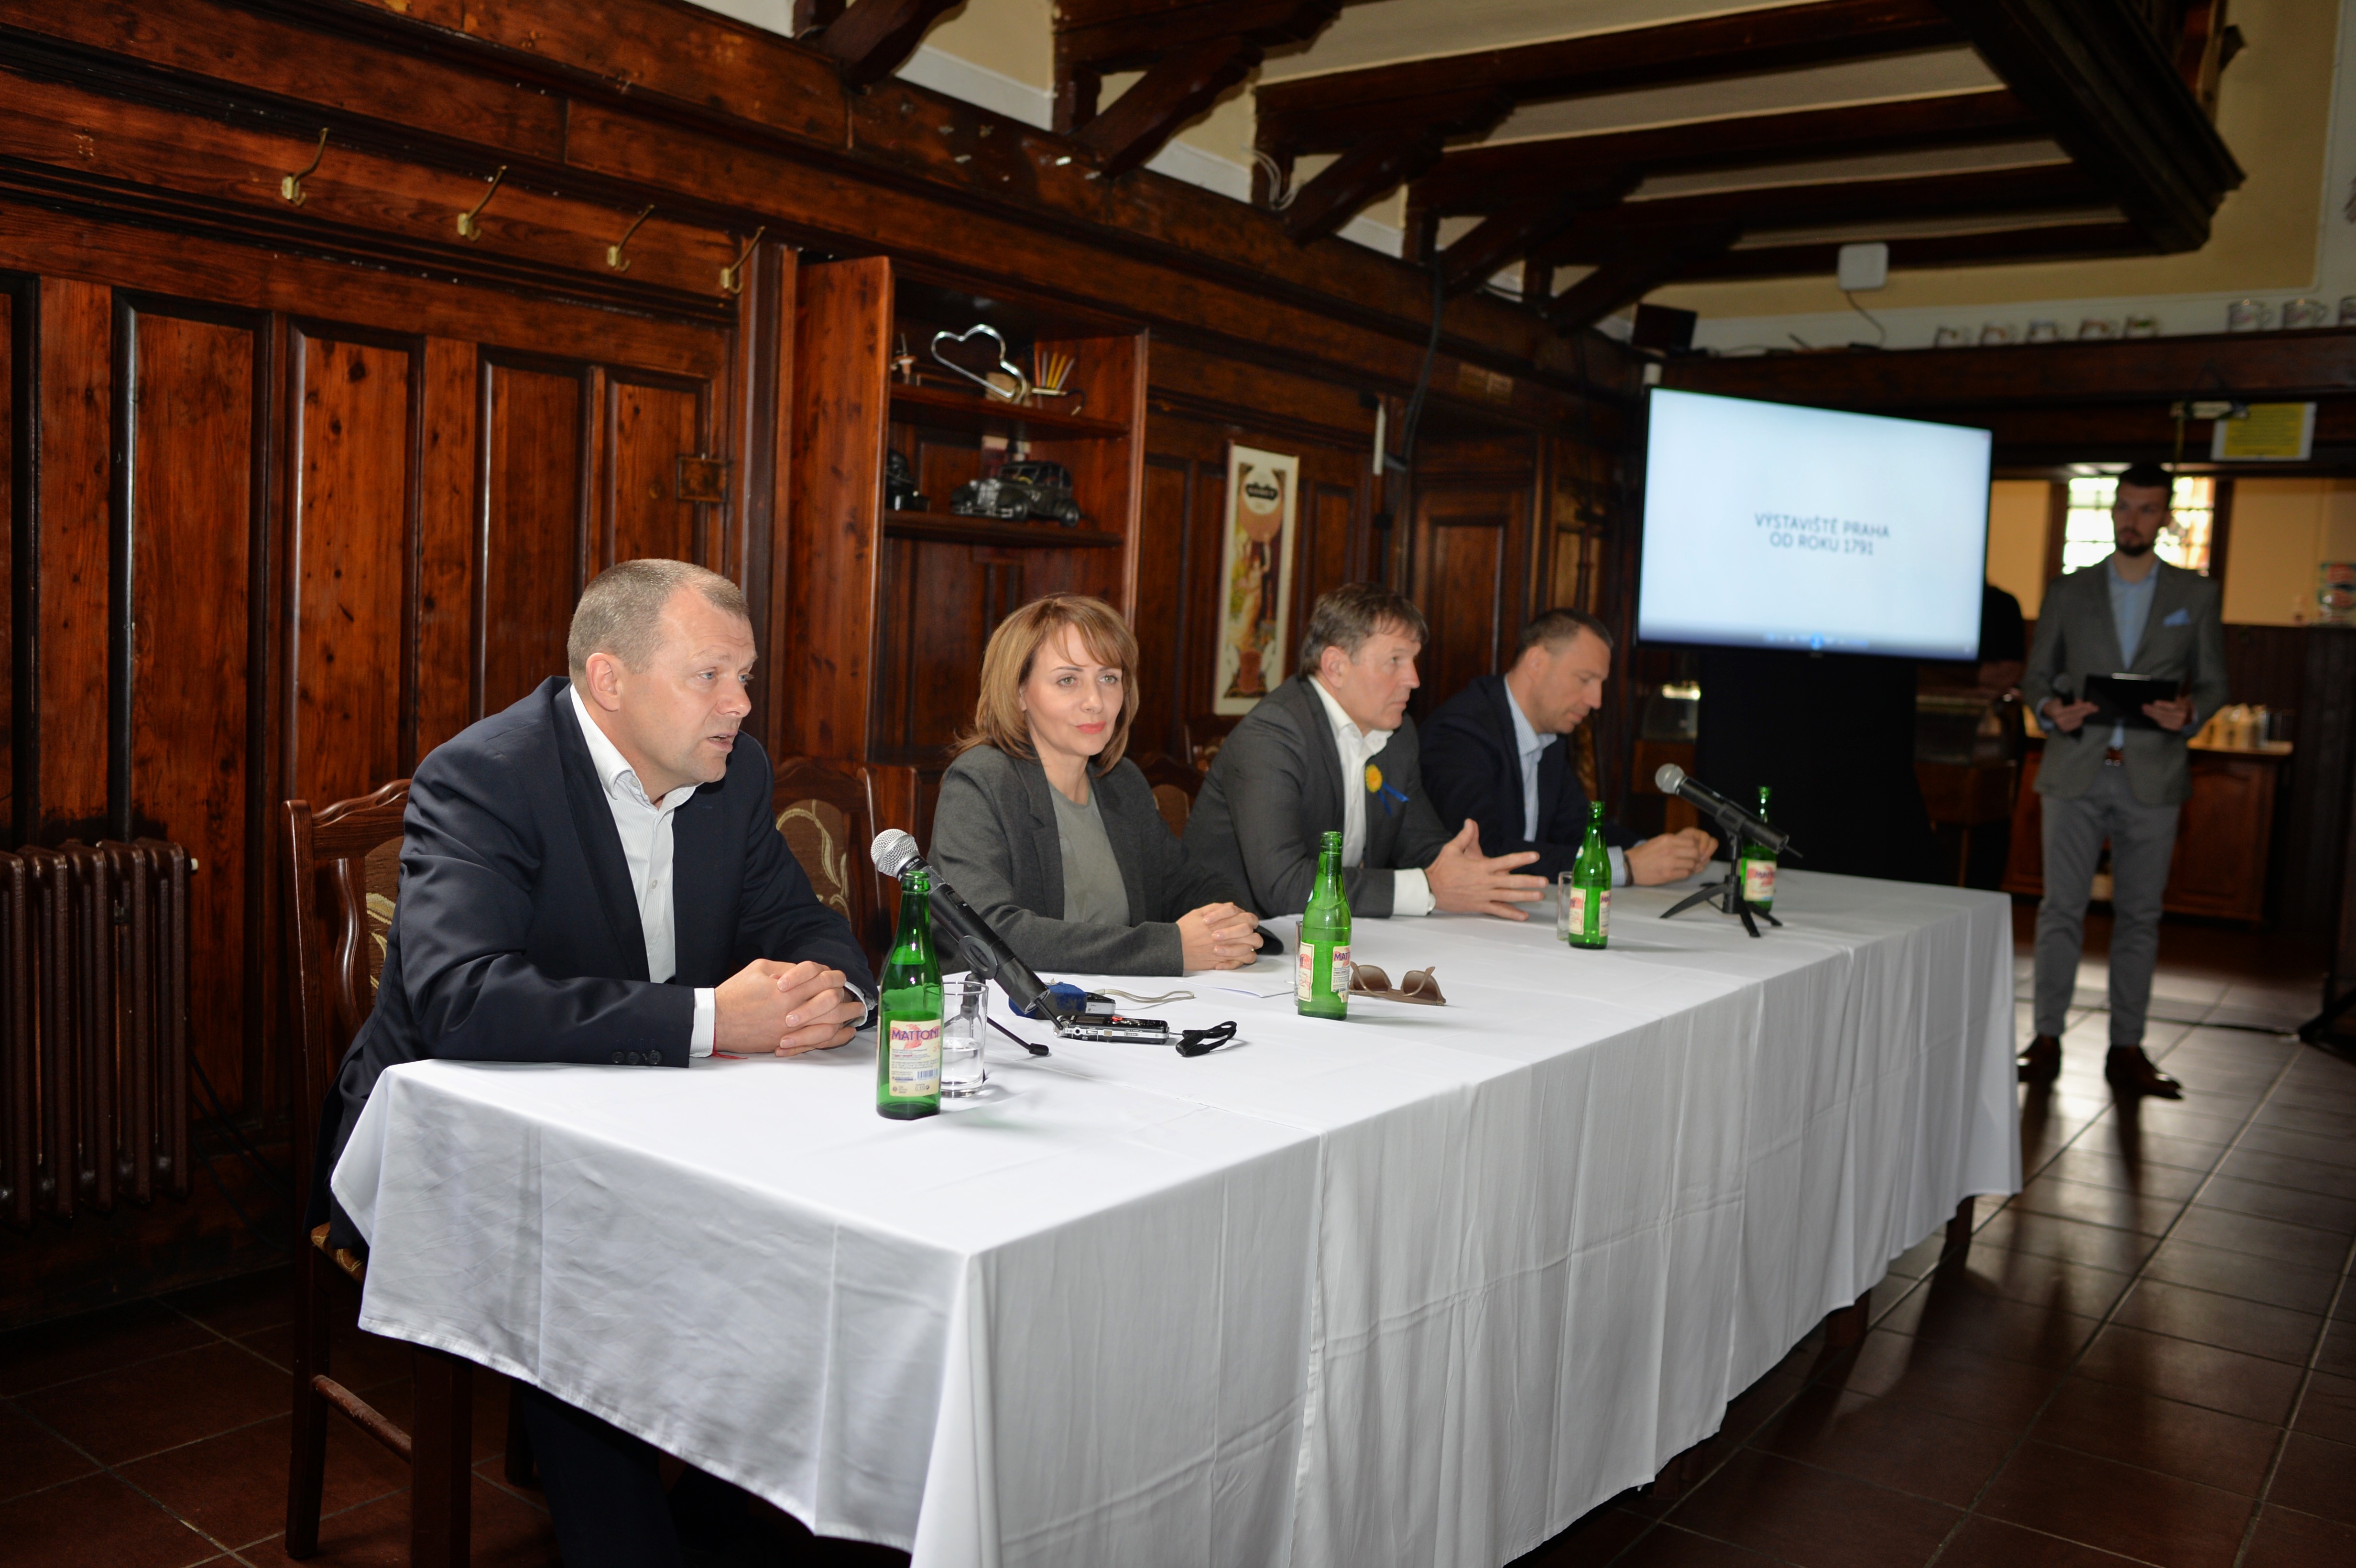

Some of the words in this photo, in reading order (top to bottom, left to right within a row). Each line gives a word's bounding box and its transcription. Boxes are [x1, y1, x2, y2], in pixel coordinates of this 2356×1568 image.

[1843, 521, 1889, 536] PRAHA
[1769, 531, 1793, 547] OD
[1799, 534, 1838, 551] ROKU
[1844, 540, 1873, 555] 1791
[892, 1029, 939, 1040] MATTONI
